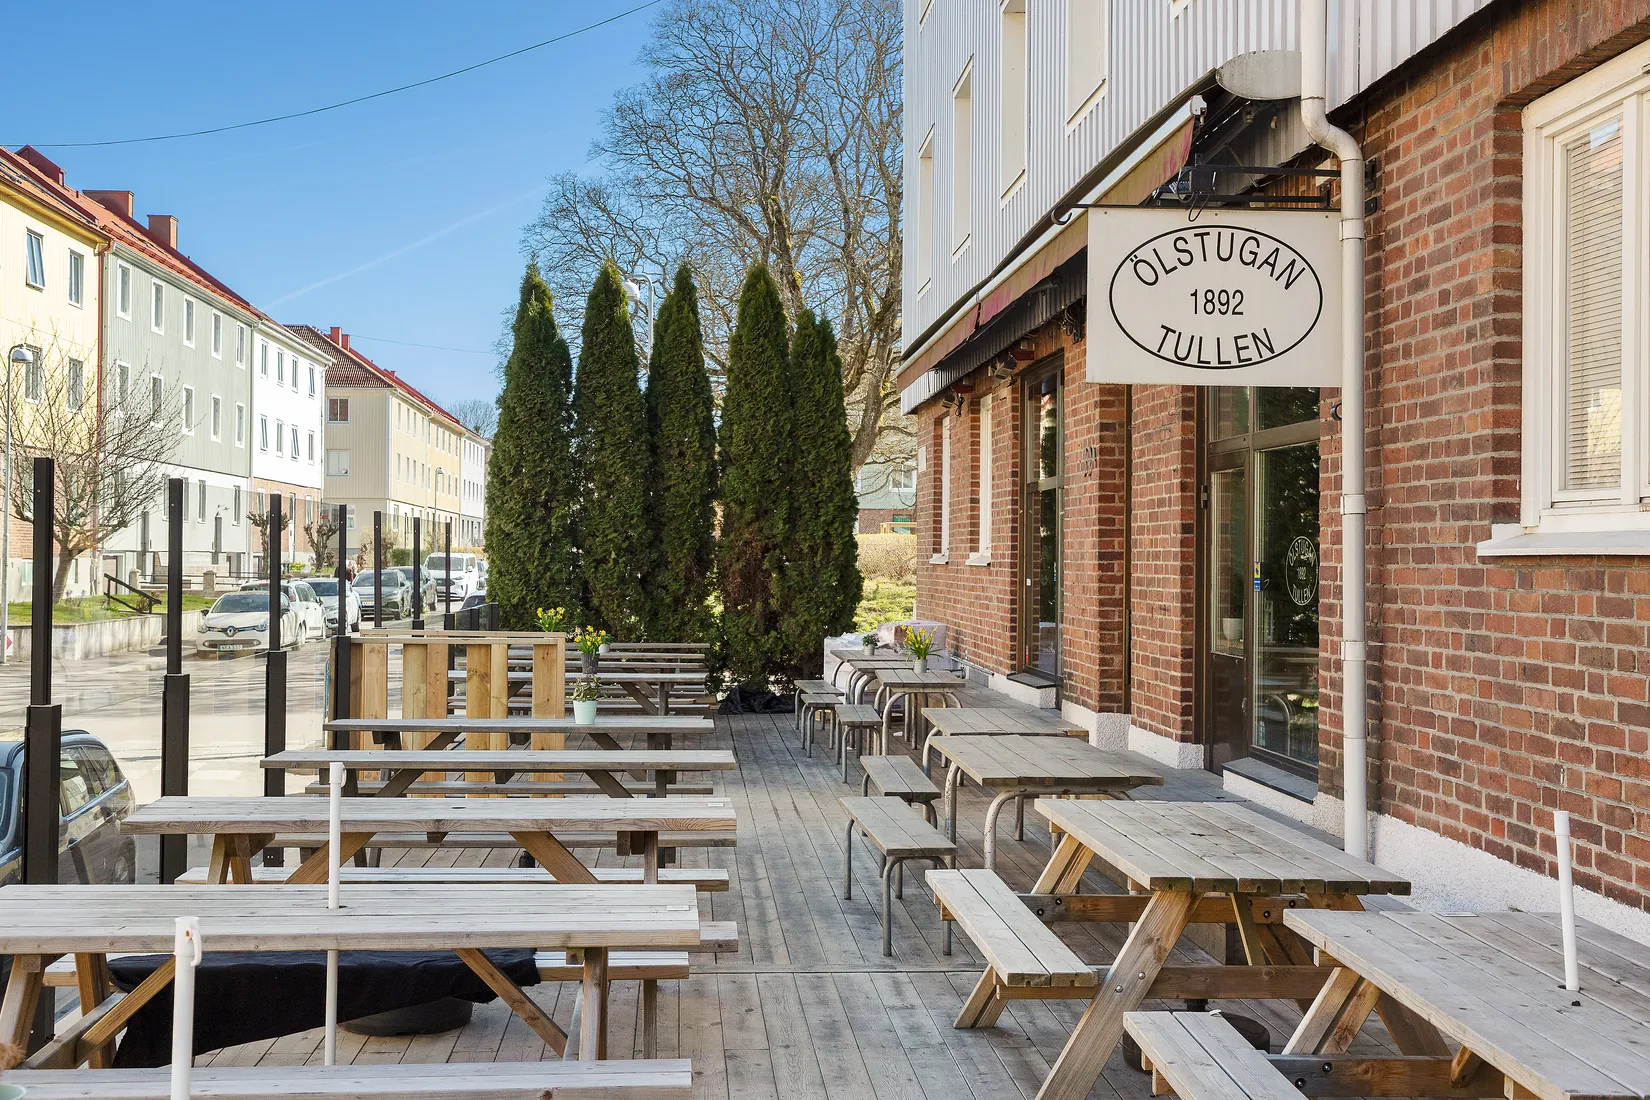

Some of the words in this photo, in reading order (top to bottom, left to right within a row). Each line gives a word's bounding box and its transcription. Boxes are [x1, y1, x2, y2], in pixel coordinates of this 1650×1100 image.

[1129, 231, 1306, 291] ÖLSTUGAN
[1190, 288, 1244, 316] 1892
[1157, 324, 1276, 365] TULLEN
